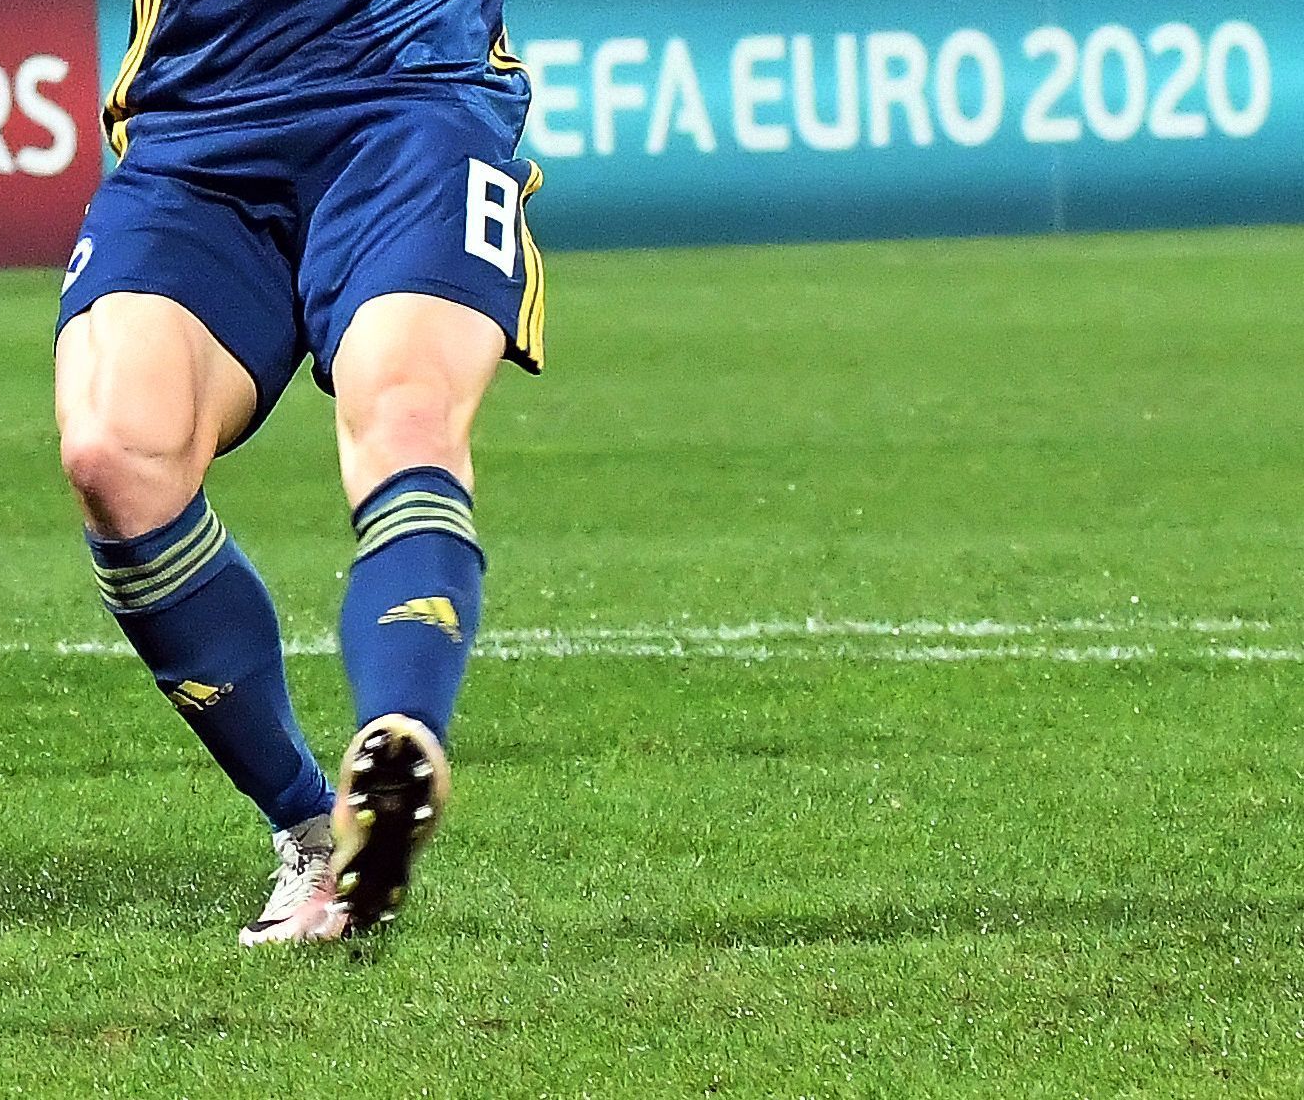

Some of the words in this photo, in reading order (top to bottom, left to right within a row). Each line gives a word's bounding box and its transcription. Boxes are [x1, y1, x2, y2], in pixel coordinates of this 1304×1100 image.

[522, 35, 718, 158] EFA
[729, 27, 1006, 152] EURO
[1021, 20, 1272, 144] 2020
[465, 157, 520, 278] 8
